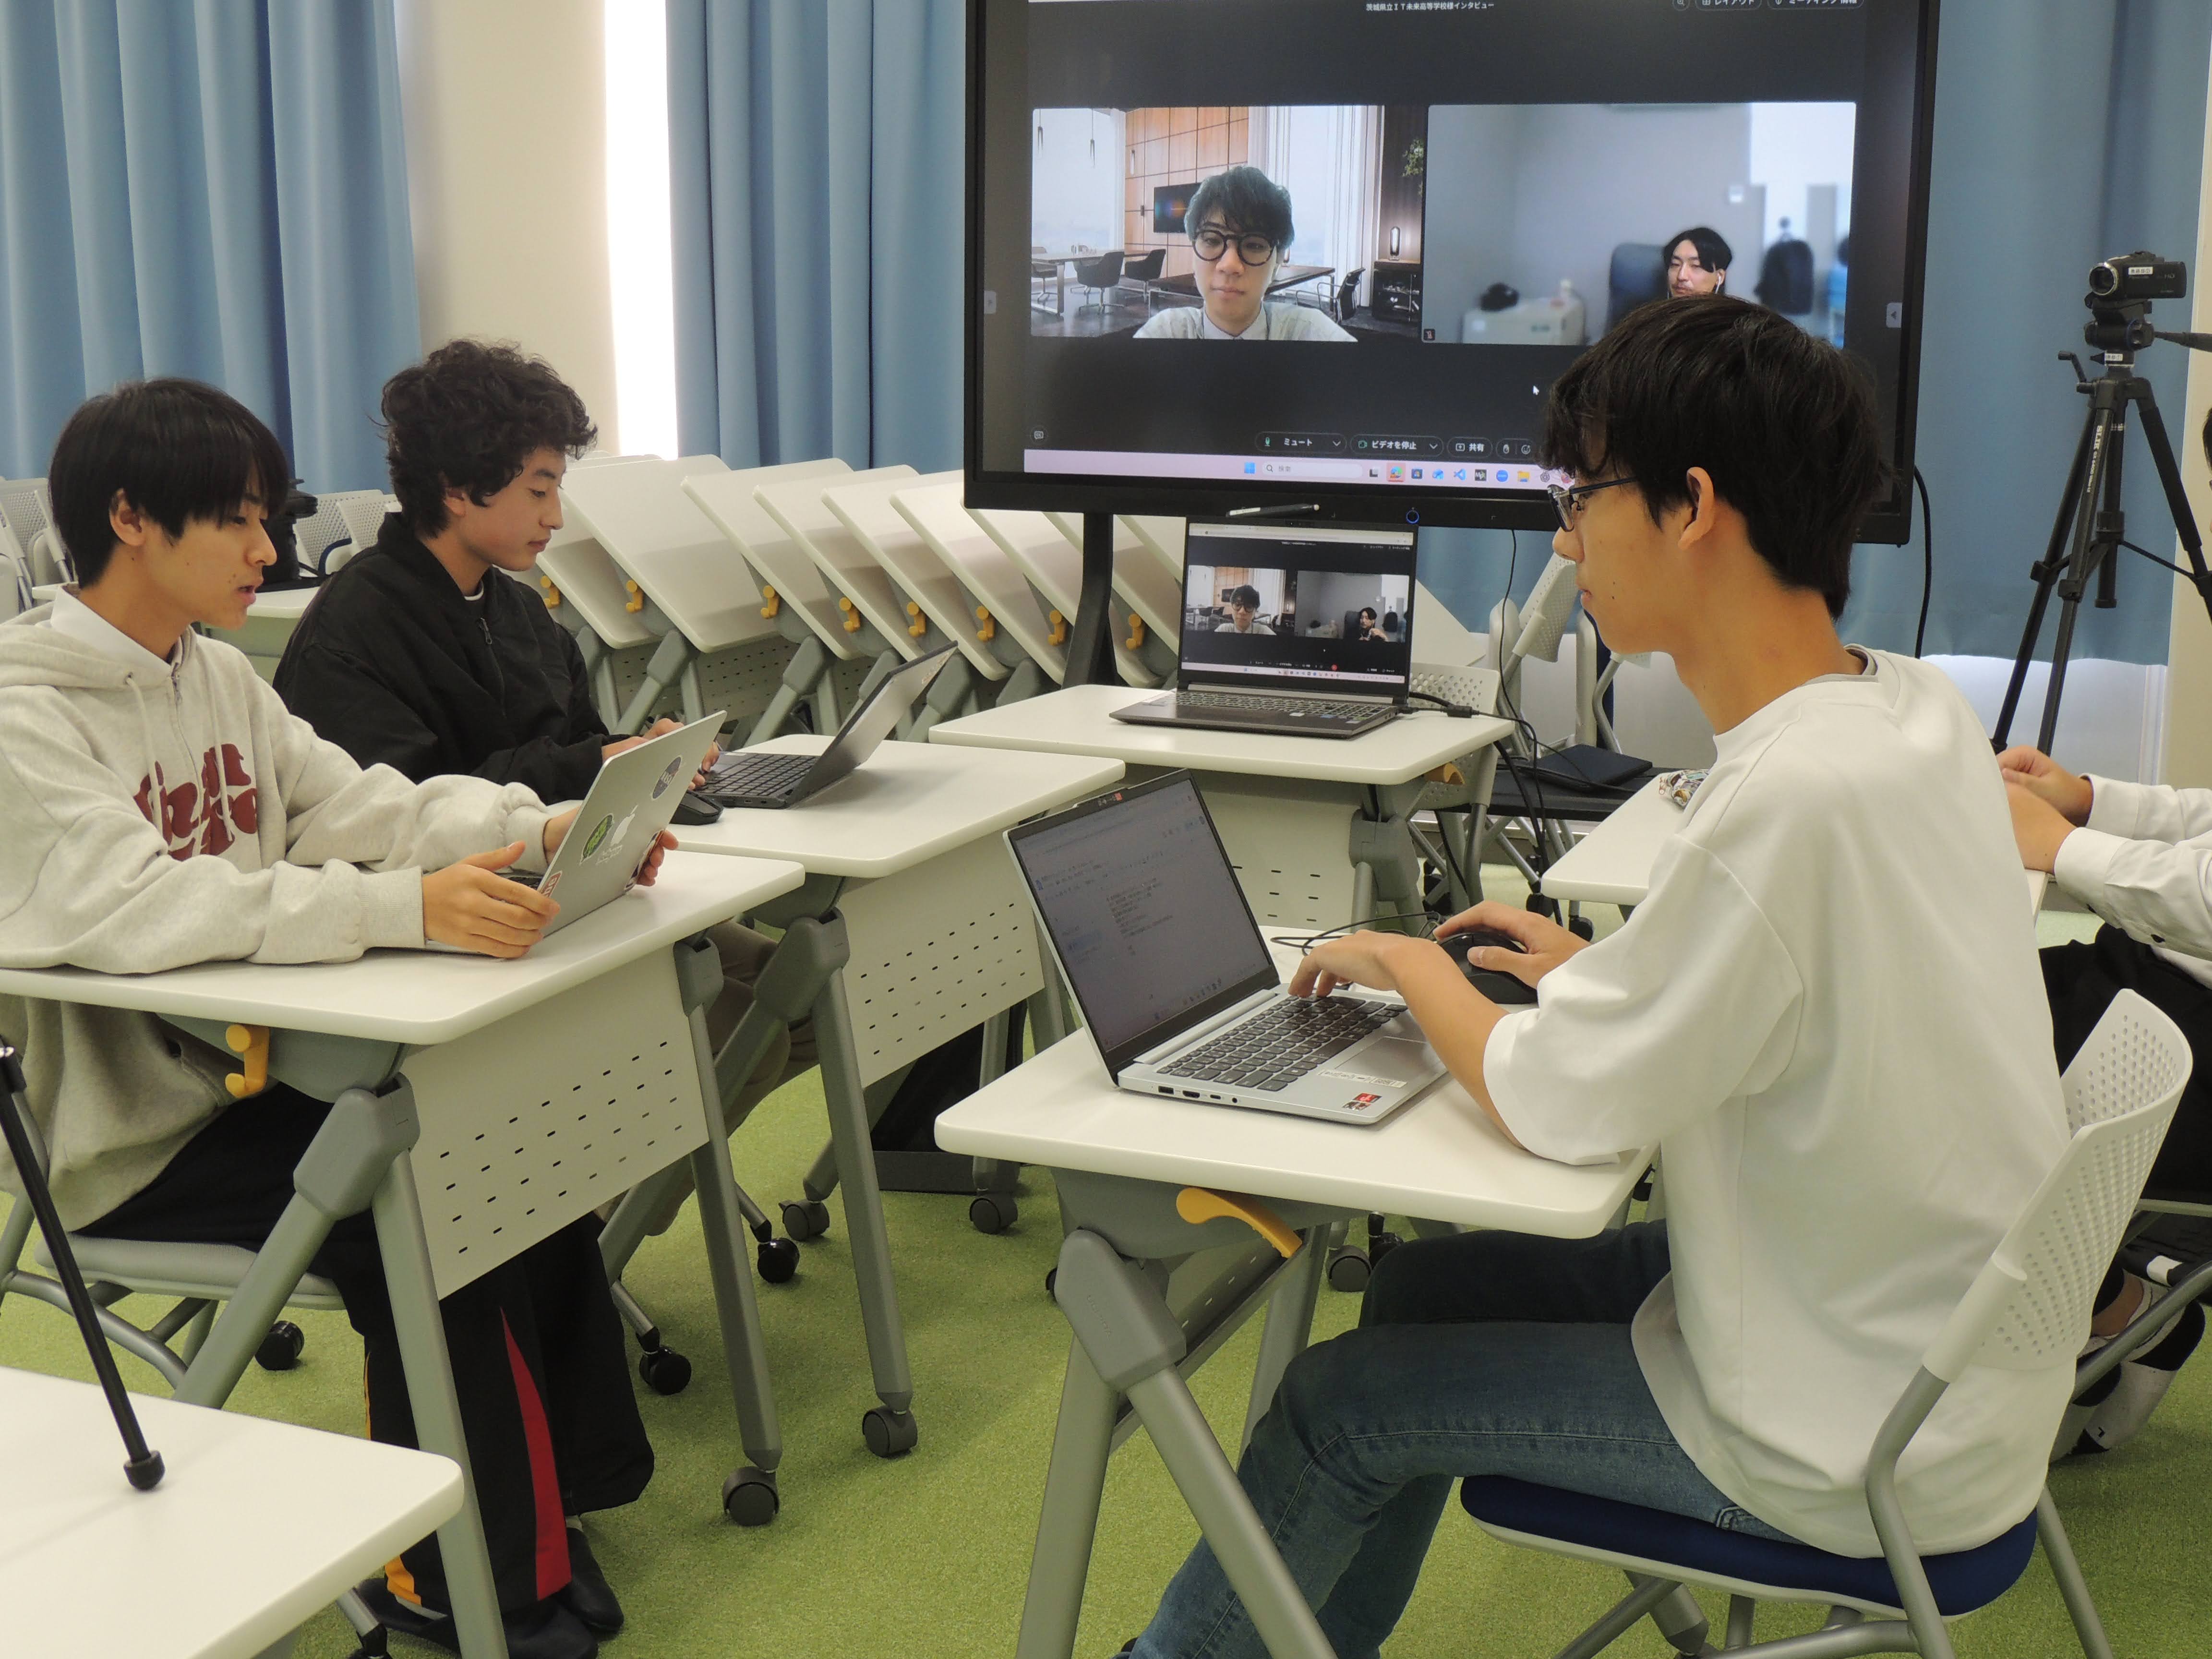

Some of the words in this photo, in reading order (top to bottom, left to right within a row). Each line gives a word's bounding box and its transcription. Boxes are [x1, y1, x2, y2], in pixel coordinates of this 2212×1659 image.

[1284, 438, 1312, 446] ミュート
[2093, 425, 2103, 450] SLIK
[1372, 440, 1417, 450] ビデオを停止
[1468, 443, 1485, 452] 共有
